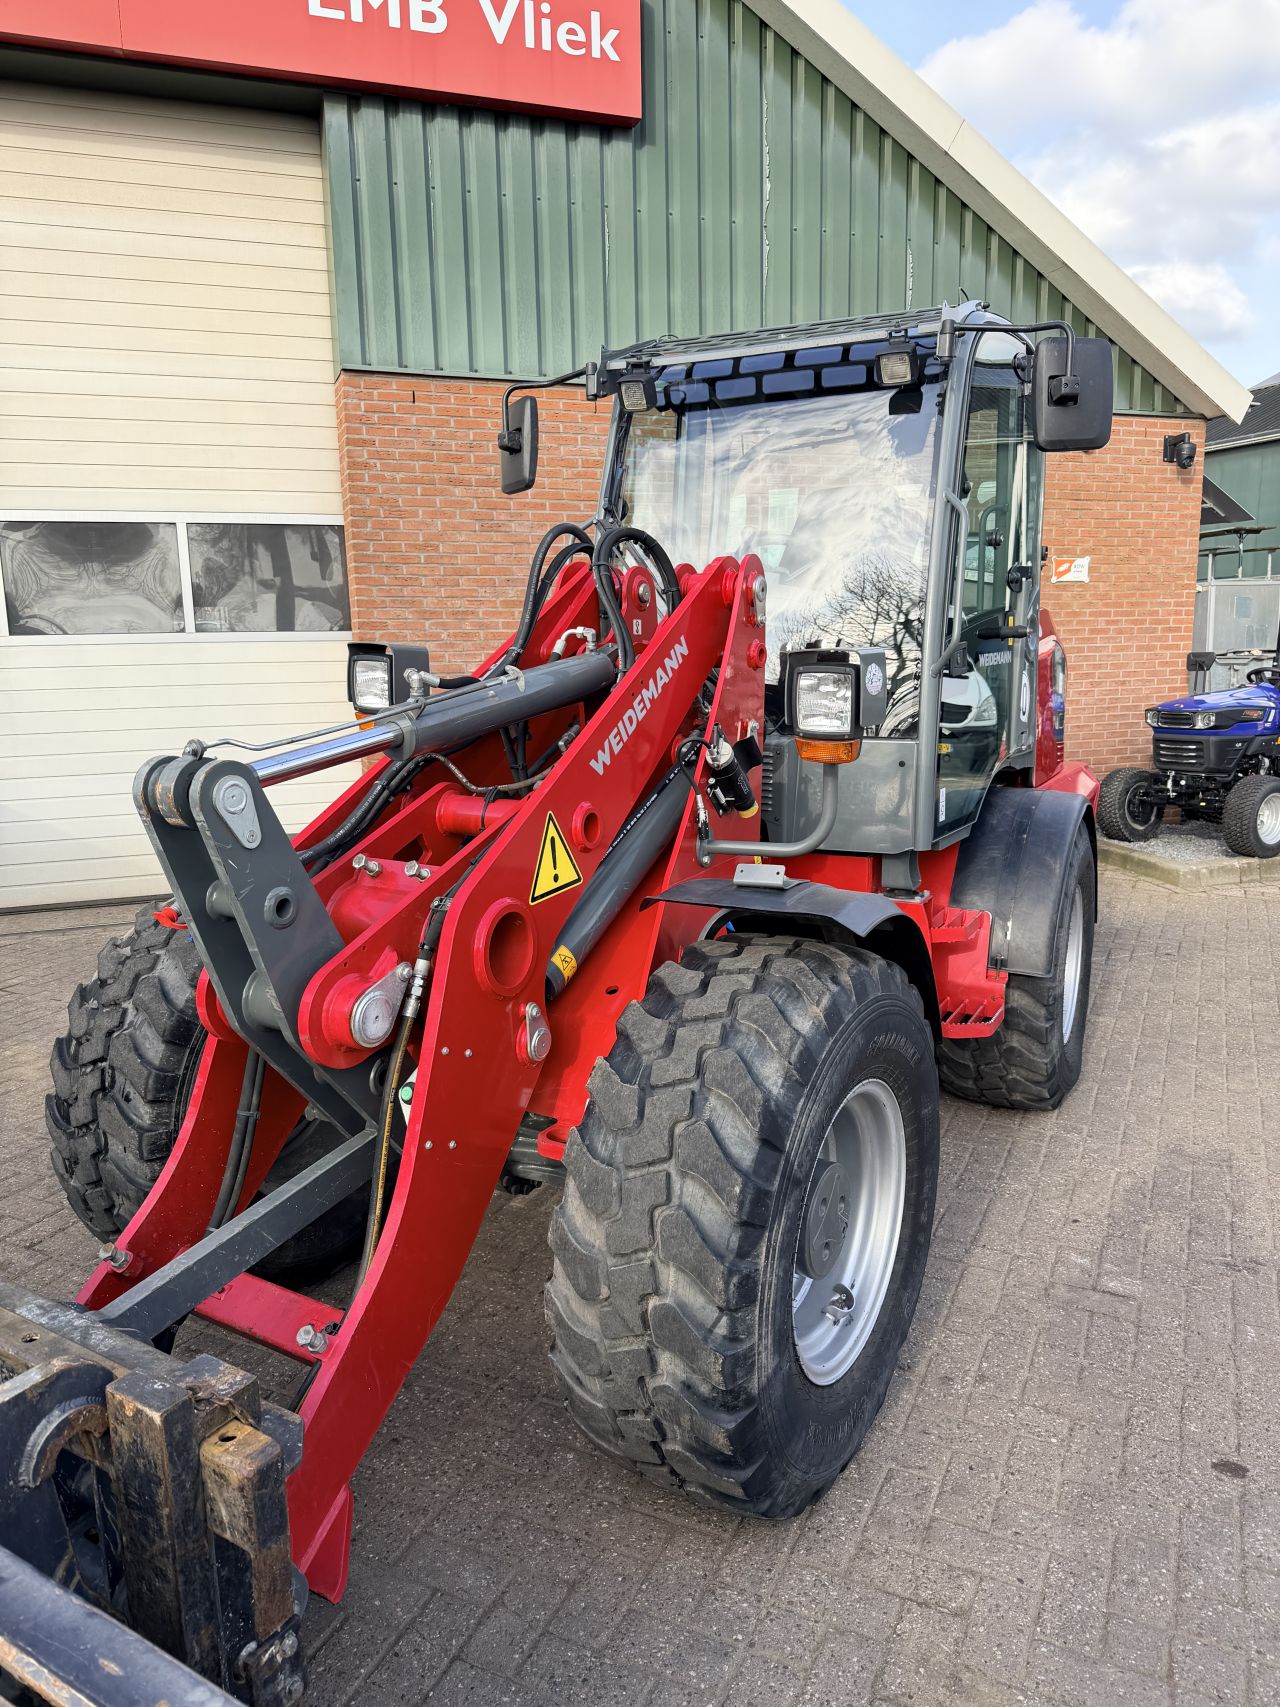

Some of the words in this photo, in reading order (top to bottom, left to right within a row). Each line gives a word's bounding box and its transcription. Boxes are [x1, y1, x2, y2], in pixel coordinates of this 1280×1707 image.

[479, 0, 621, 62] Vliek
[978, 650, 1012, 668] WEIDEMANN
[589, 634, 689, 776] WEIDEMANN
